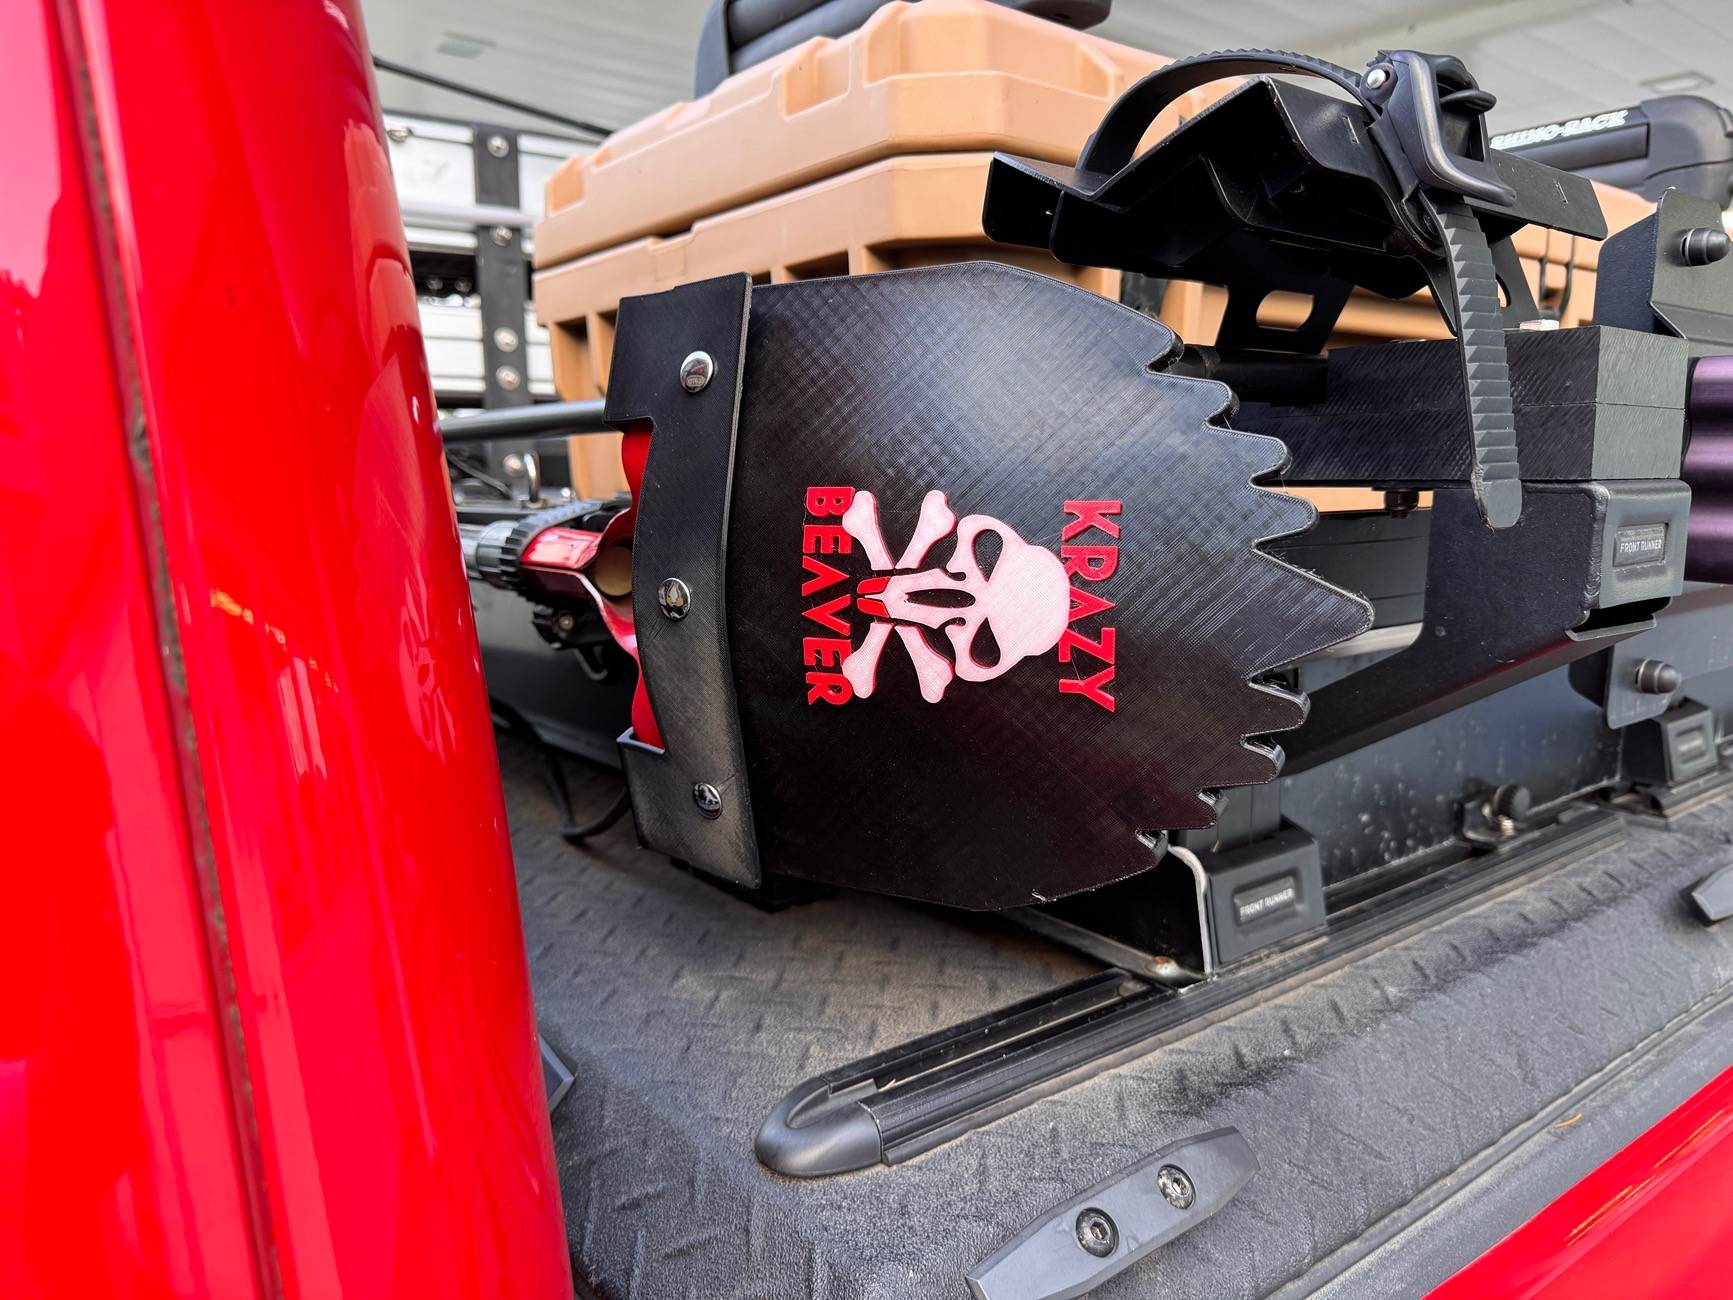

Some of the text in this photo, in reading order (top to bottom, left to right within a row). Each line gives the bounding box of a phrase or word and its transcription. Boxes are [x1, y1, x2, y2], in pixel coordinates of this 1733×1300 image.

[801, 486, 855, 705] BEAVER
[1058, 499, 1122, 712] KRAZY
[1620, 539, 1662, 553] FRONT RUNNER
[1240, 887, 1294, 917] FRONT RUNNER
